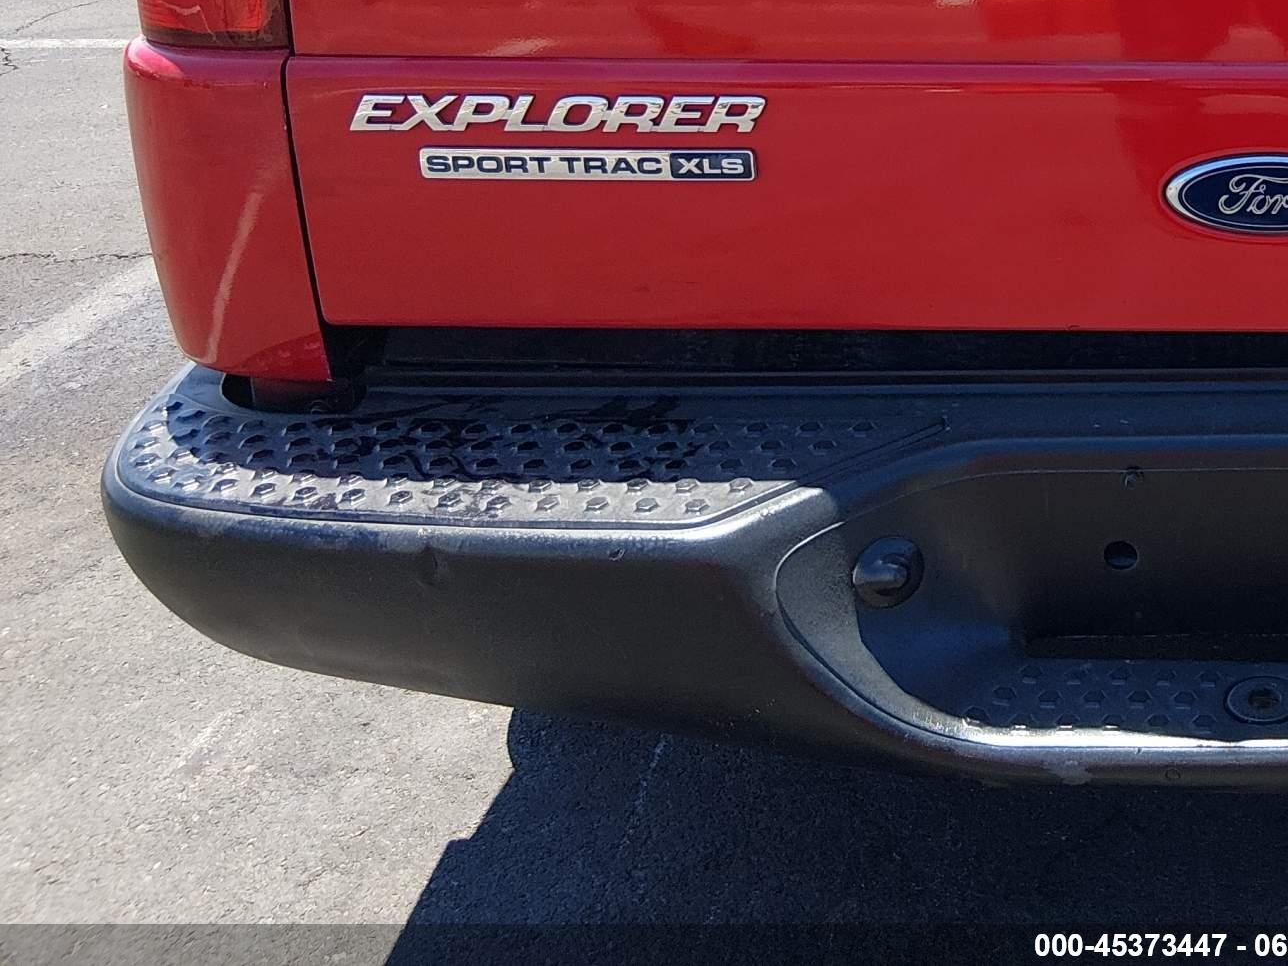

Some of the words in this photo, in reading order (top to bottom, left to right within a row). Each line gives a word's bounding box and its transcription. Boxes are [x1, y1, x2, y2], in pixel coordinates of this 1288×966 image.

[349, 94, 767, 133] EXPLORER
[425, 155, 546, 175] SPORT
[557, 155, 664, 175] TRAC
[676, 157, 745, 175] XLS
